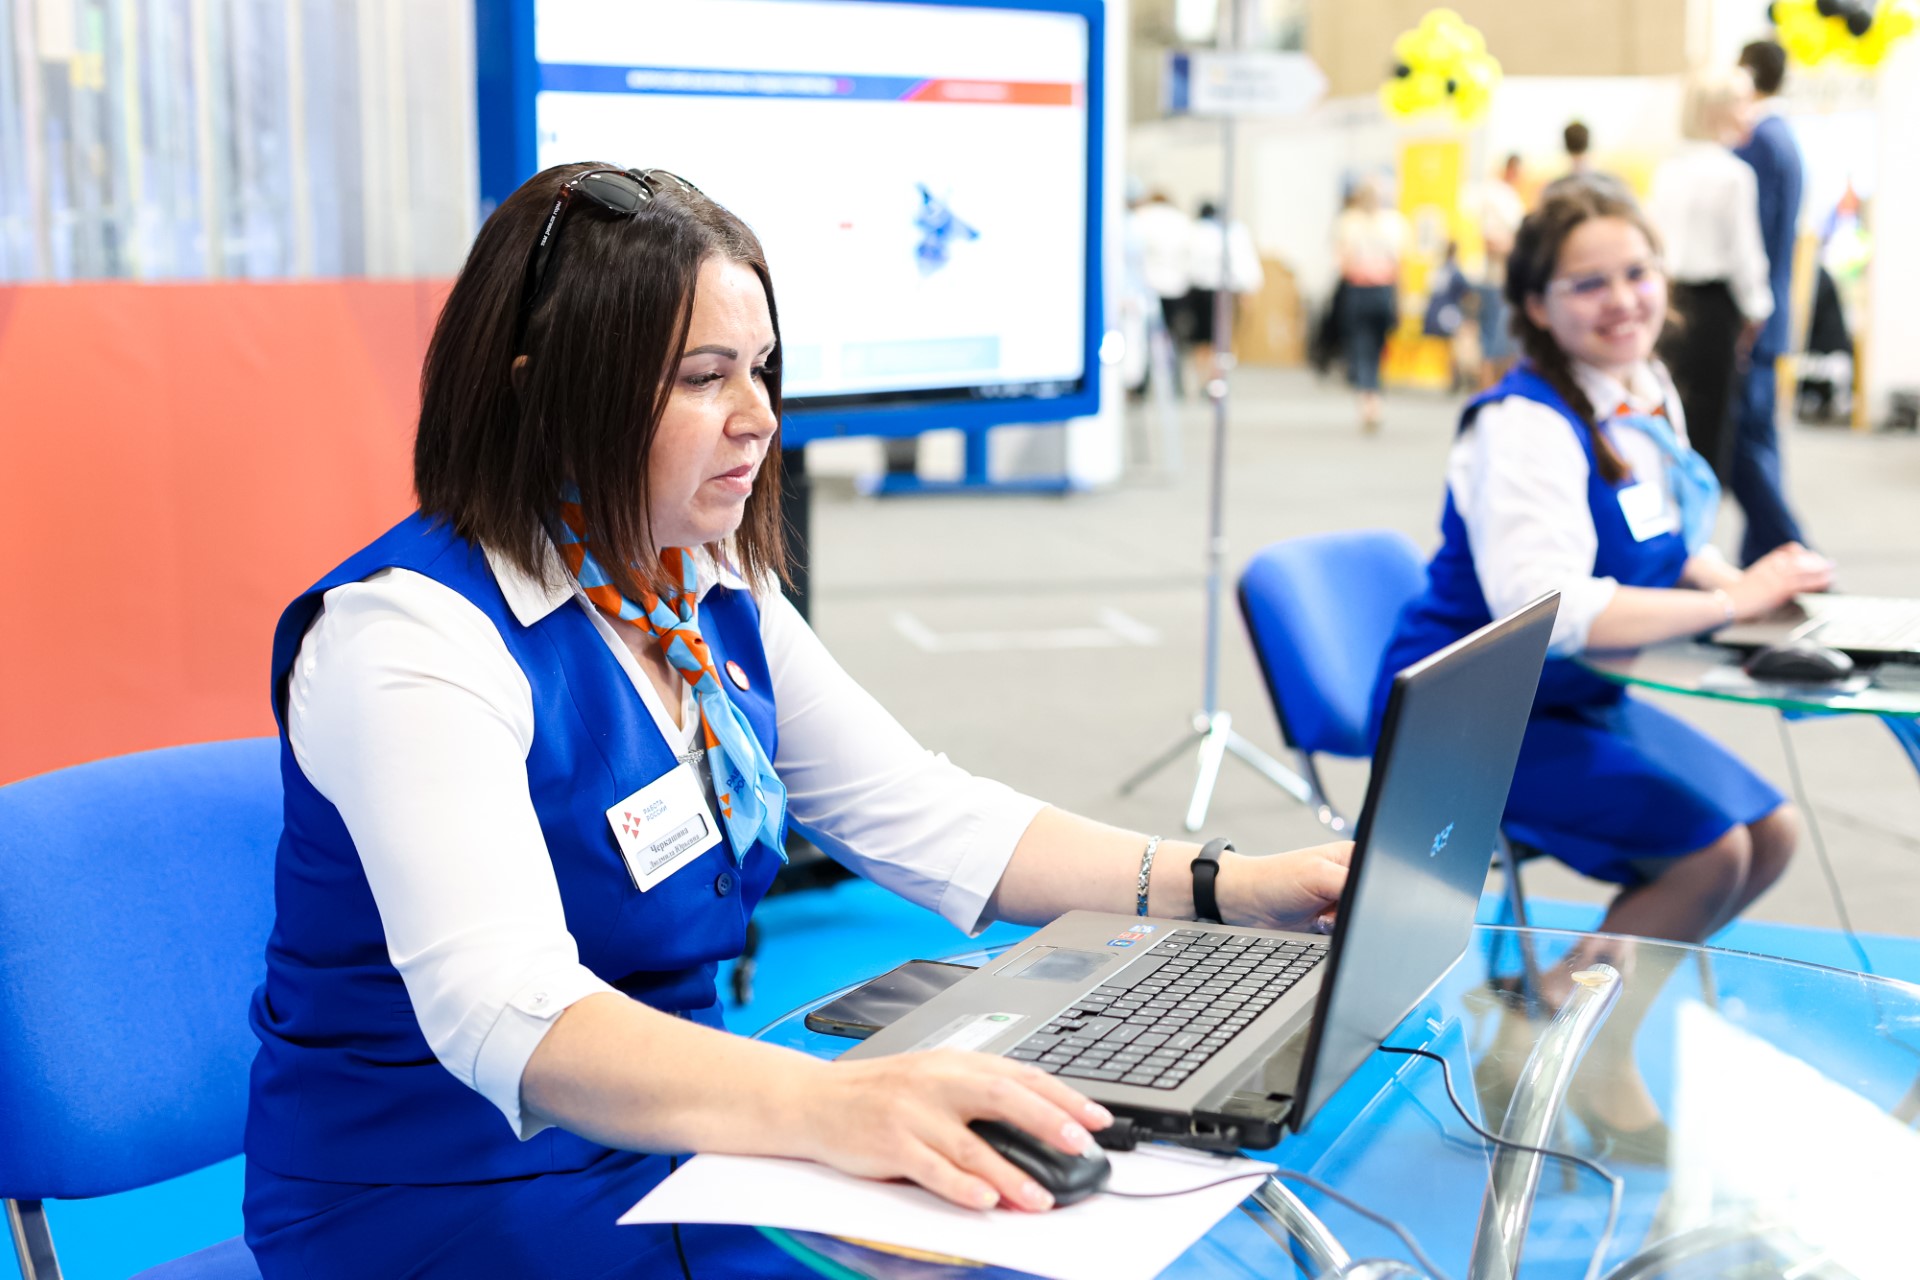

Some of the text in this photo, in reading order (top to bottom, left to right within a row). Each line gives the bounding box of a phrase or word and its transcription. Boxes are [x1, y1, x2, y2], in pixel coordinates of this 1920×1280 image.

[642, 799, 663, 814] РАБОТА
[645, 805, 667, 822] РОССИИ
[650, 827, 689, 854] Черкашина
[649, 834, 700, 870] Людмила Юрьевна
